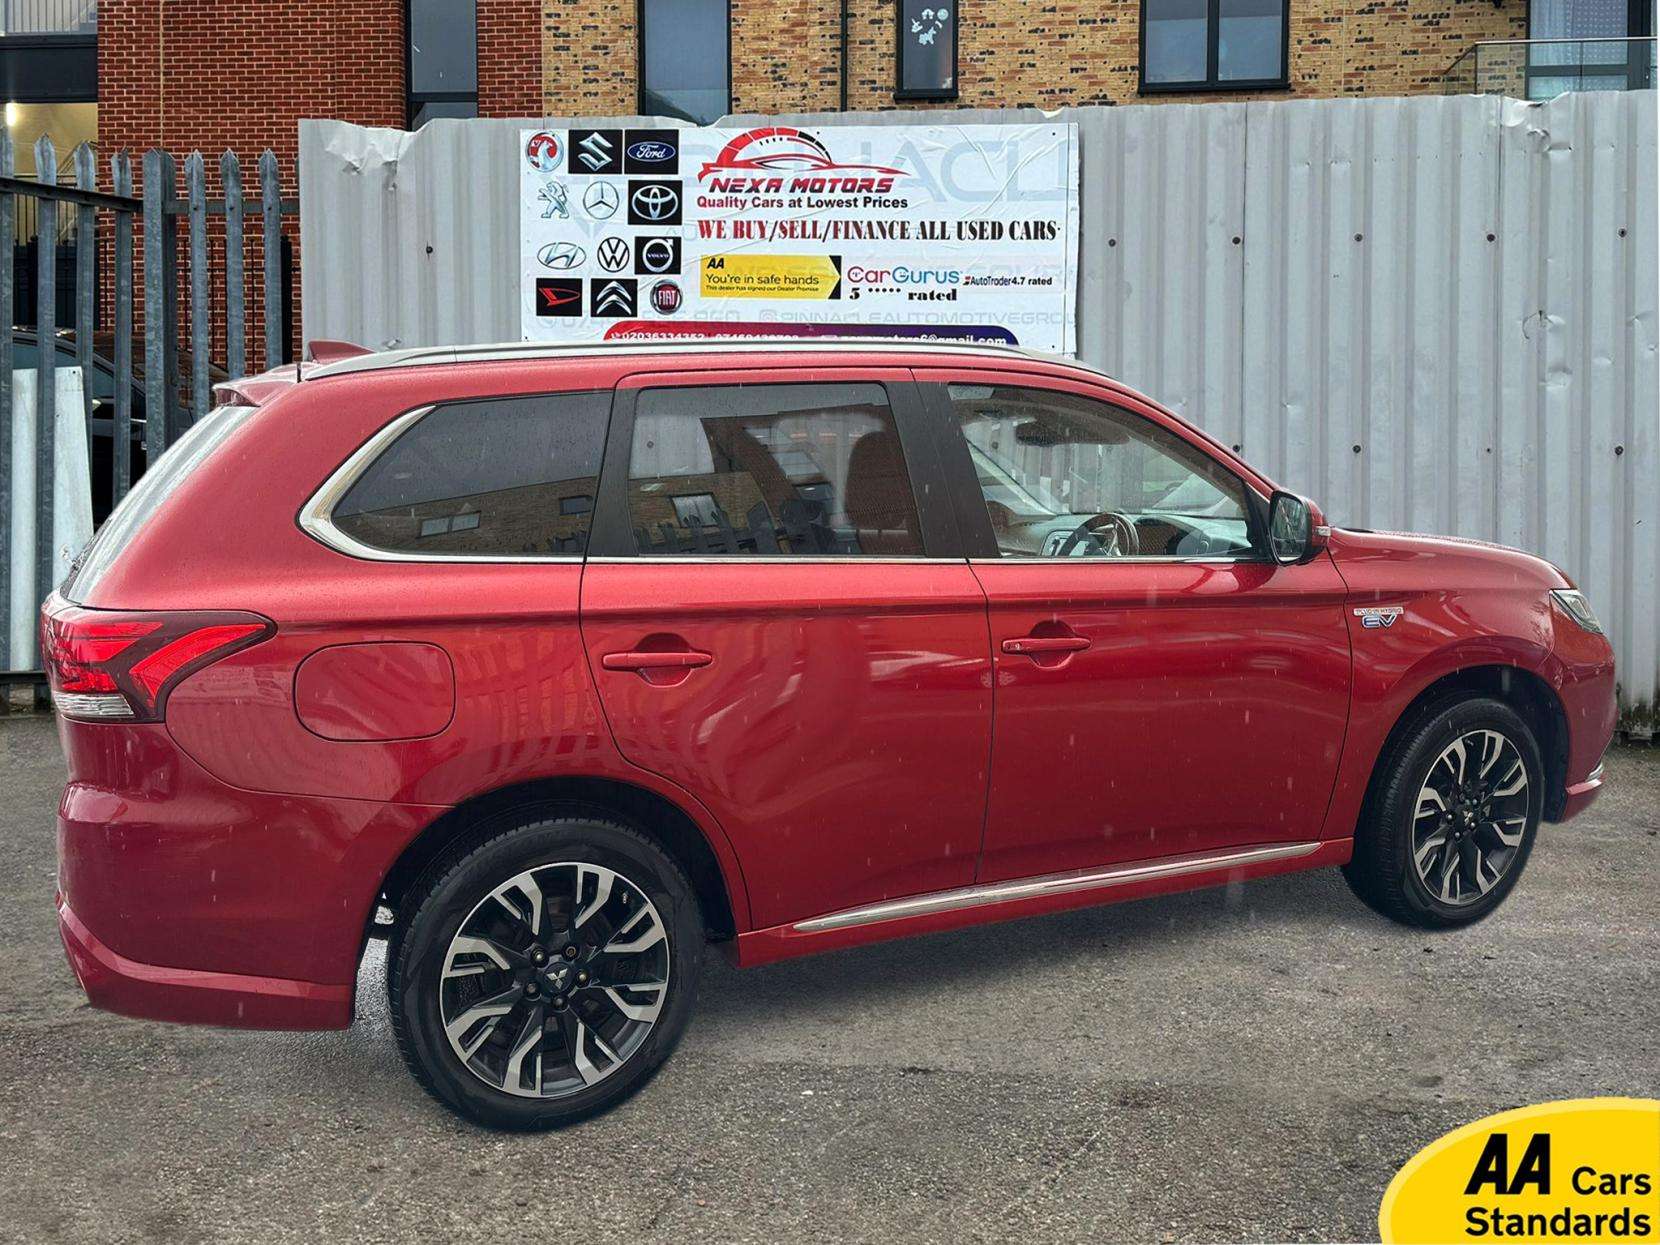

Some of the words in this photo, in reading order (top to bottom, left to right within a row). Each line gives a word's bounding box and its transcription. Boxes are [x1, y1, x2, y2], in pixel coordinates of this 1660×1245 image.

[636, 144, 666, 159] Ford
[709, 178, 783, 193] NEXA
[789, 178, 895, 193] MOTORS
[697, 196, 746, 210] Quality
[752, 196, 784, 208] Cars
[788, 196, 803, 208] at
[807, 196, 859, 208] Lowest
[863, 196, 908, 208] Prices
[698, 220, 727, 240] WE
[916, 220, 951, 240] ALL
[956, 220, 1004, 240] USED
[707, 257, 725, 269] AA
[706, 274, 741, 284] You're
[744, 274, 754, 284] in
[757, 274, 781, 285] safe
[784, 275, 820, 285] hands
[847, 266, 960, 284] CarGurus
[1028, 276, 1053, 286] rated
[658, 290, 676, 305] FIAT
[849, 287, 860, 300] 5
[908, 288, 957, 301] rated
[1362, 614, 1397, 628] EV
